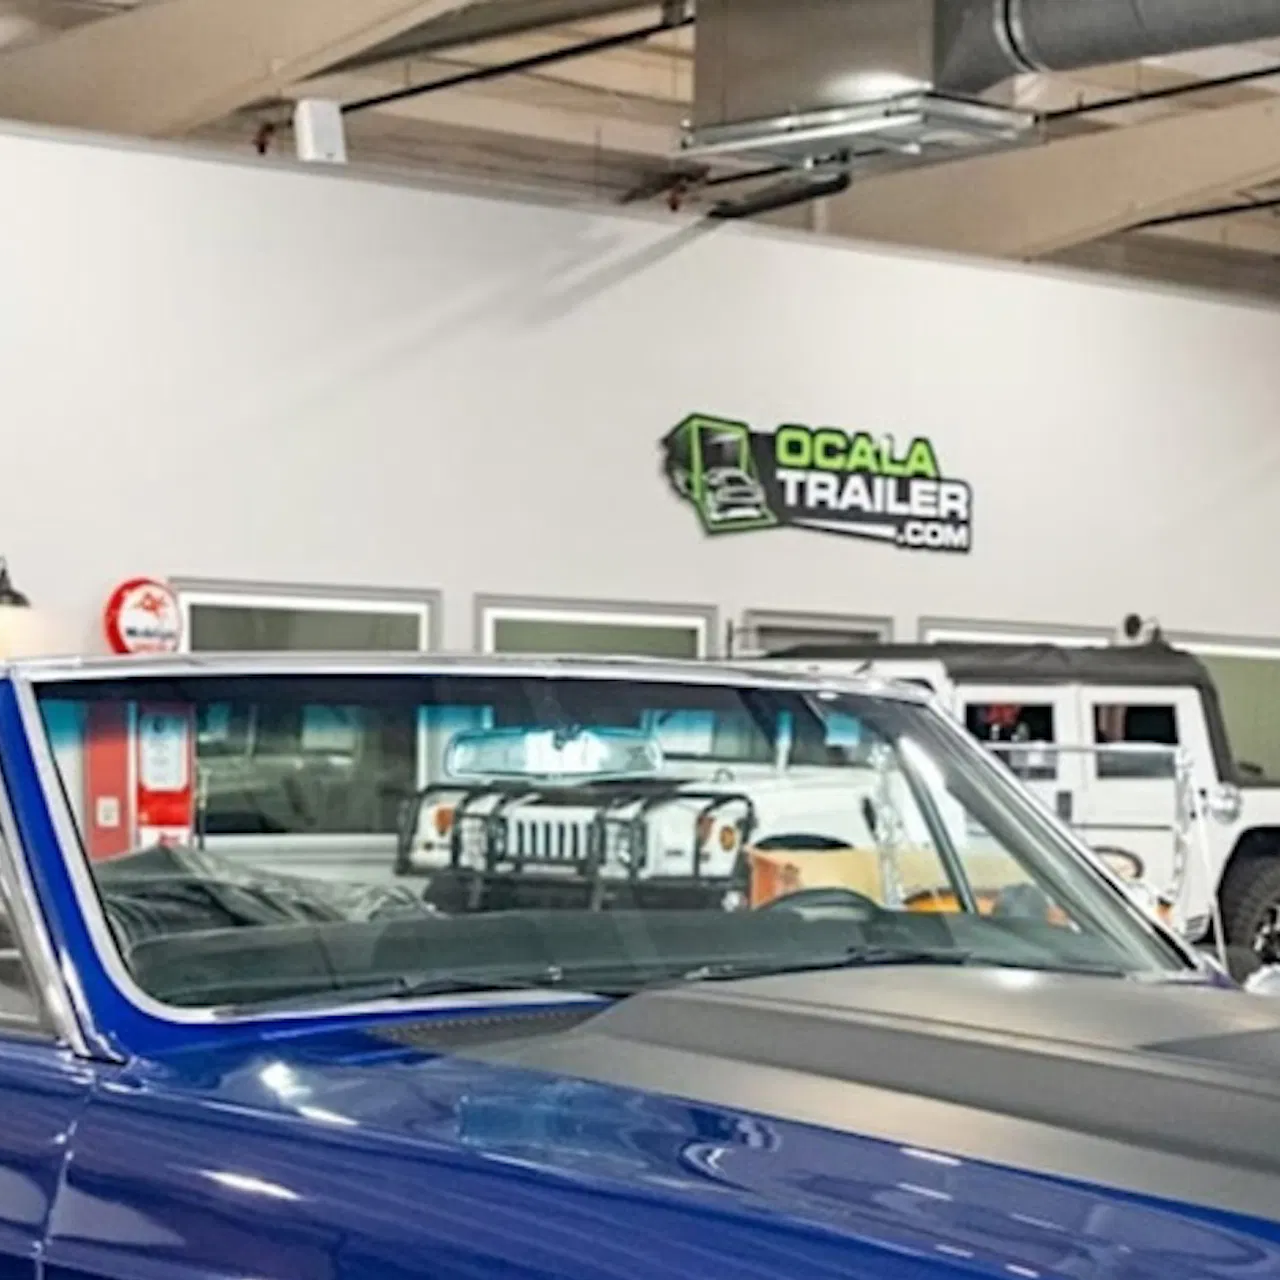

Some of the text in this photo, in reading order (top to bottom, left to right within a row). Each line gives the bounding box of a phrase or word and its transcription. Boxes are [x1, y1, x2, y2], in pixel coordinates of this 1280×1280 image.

[775, 426, 937, 478] OCALA
[774, 468, 969, 519] TRAILER
[896, 521, 969, 549] .COM
